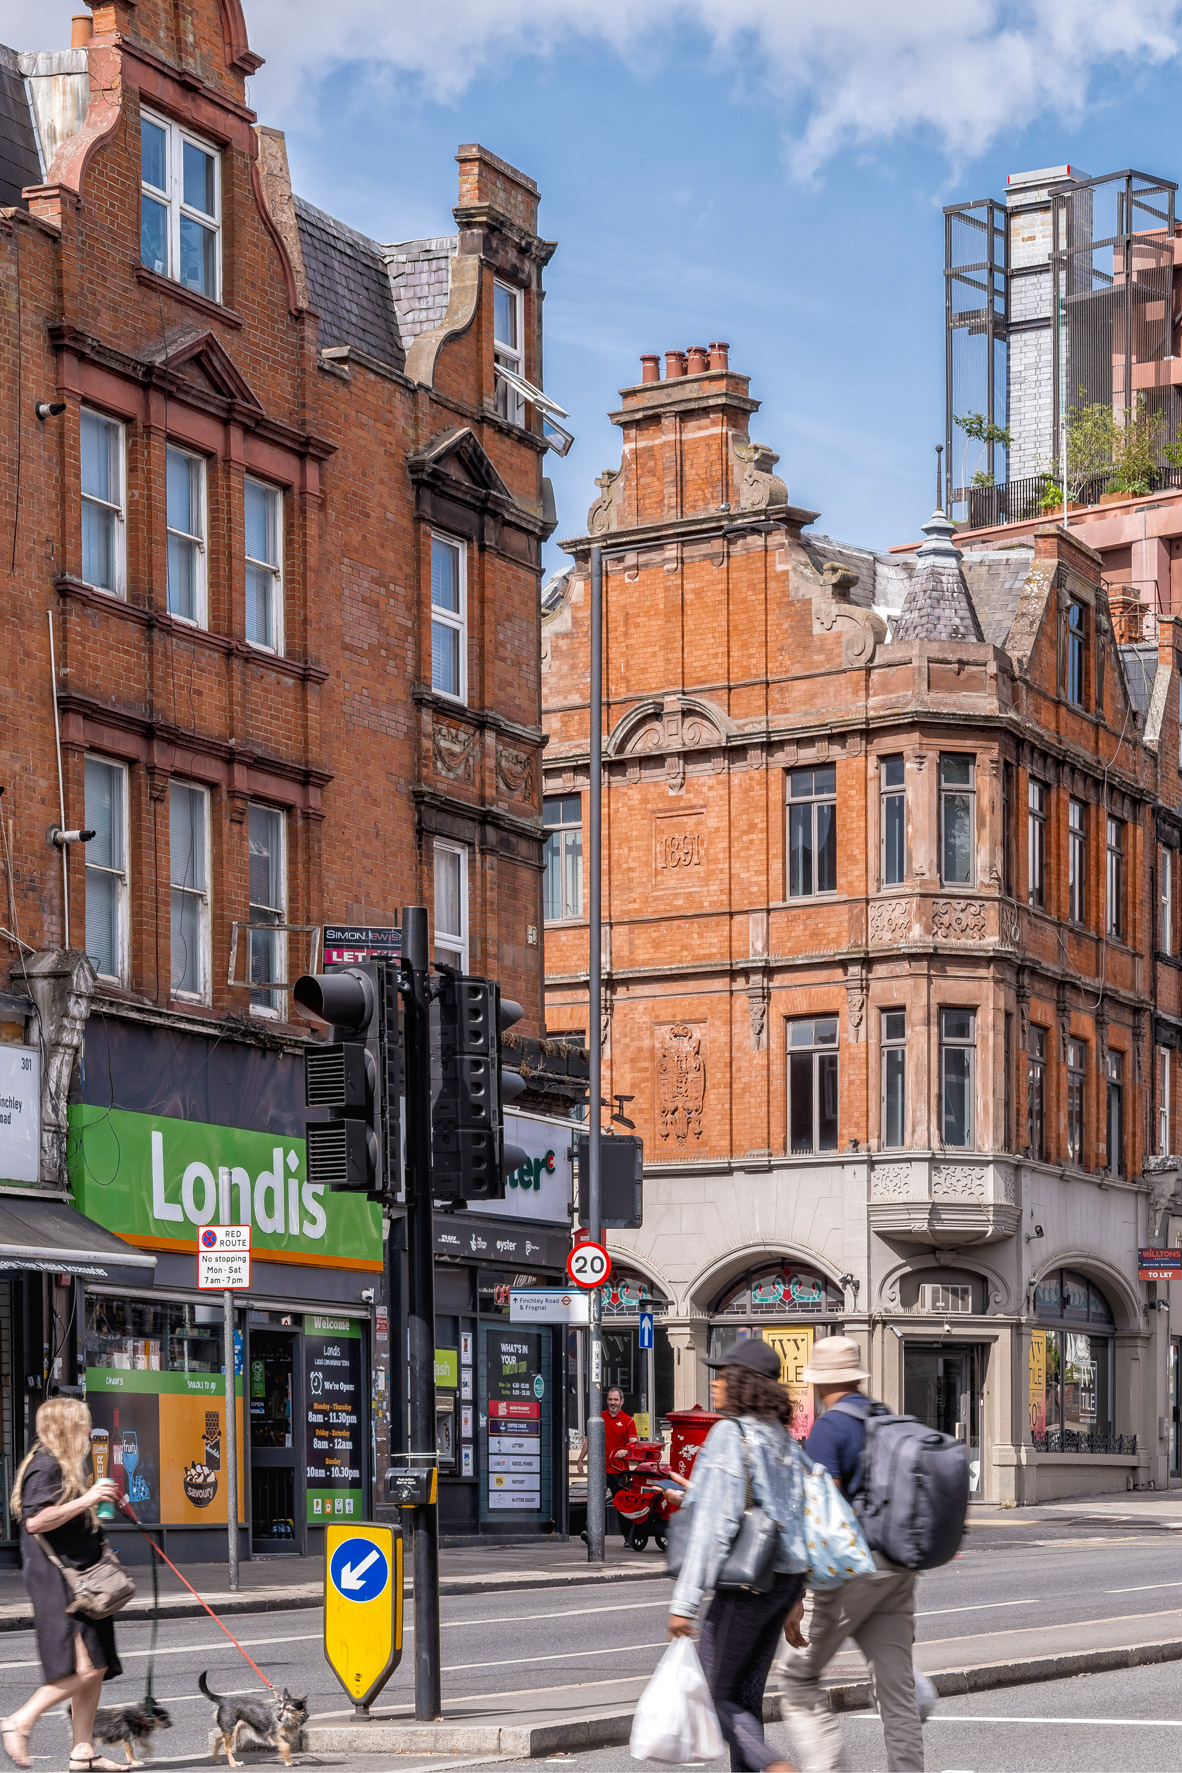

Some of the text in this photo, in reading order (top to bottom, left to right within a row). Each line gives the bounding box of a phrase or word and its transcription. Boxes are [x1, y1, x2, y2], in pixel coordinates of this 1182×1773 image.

[660, 832, 701, 869] 1891
[332, 950, 366, 962] LET
[21, 1058, 32, 1071] 301
[151, 1130, 327, 1240] Londis
[225, 1230, 242, 1238] RED
[219, 1239, 247, 1247] ROUTE
[496, 1239, 518, 1252] oyster
[202, 1255, 247, 1264] No stopping
[575, 1255, 605, 1275] 20
[207, 1266, 223, 1274] Mon
[228, 1266, 242, 1274] Sat
[519, 1297, 544, 1305] Finchley
[313, 1317, 350, 1331] Welcome
[323, 1345, 341, 1357] Londis
[500, 1343, 529, 1354] WHAT'S IN
[602, 1335, 631, 1362] VY
[1029, 1341, 1043, 1362] VY
[500, 1355, 517, 1365] YOUR
[434, 1361, 451, 1377] ash
[782, 1365, 805, 1383] ILE
[603, 1367, 629, 1388] ILE
[323, 1381, 339, 1391] We're
[307, 1411, 324, 1423] 8am
[329, 1412, 357, 1426] 11.30pm
[123, 1440, 137, 1455] fruity
[313, 1438, 328, 1449] 8am
[334, 1438, 353, 1449] 12am
[306, 1466, 326, 1478] 10am
[331, 1467, 360, 1480] 10.30pm
[187, 1485, 214, 1499] savoury
